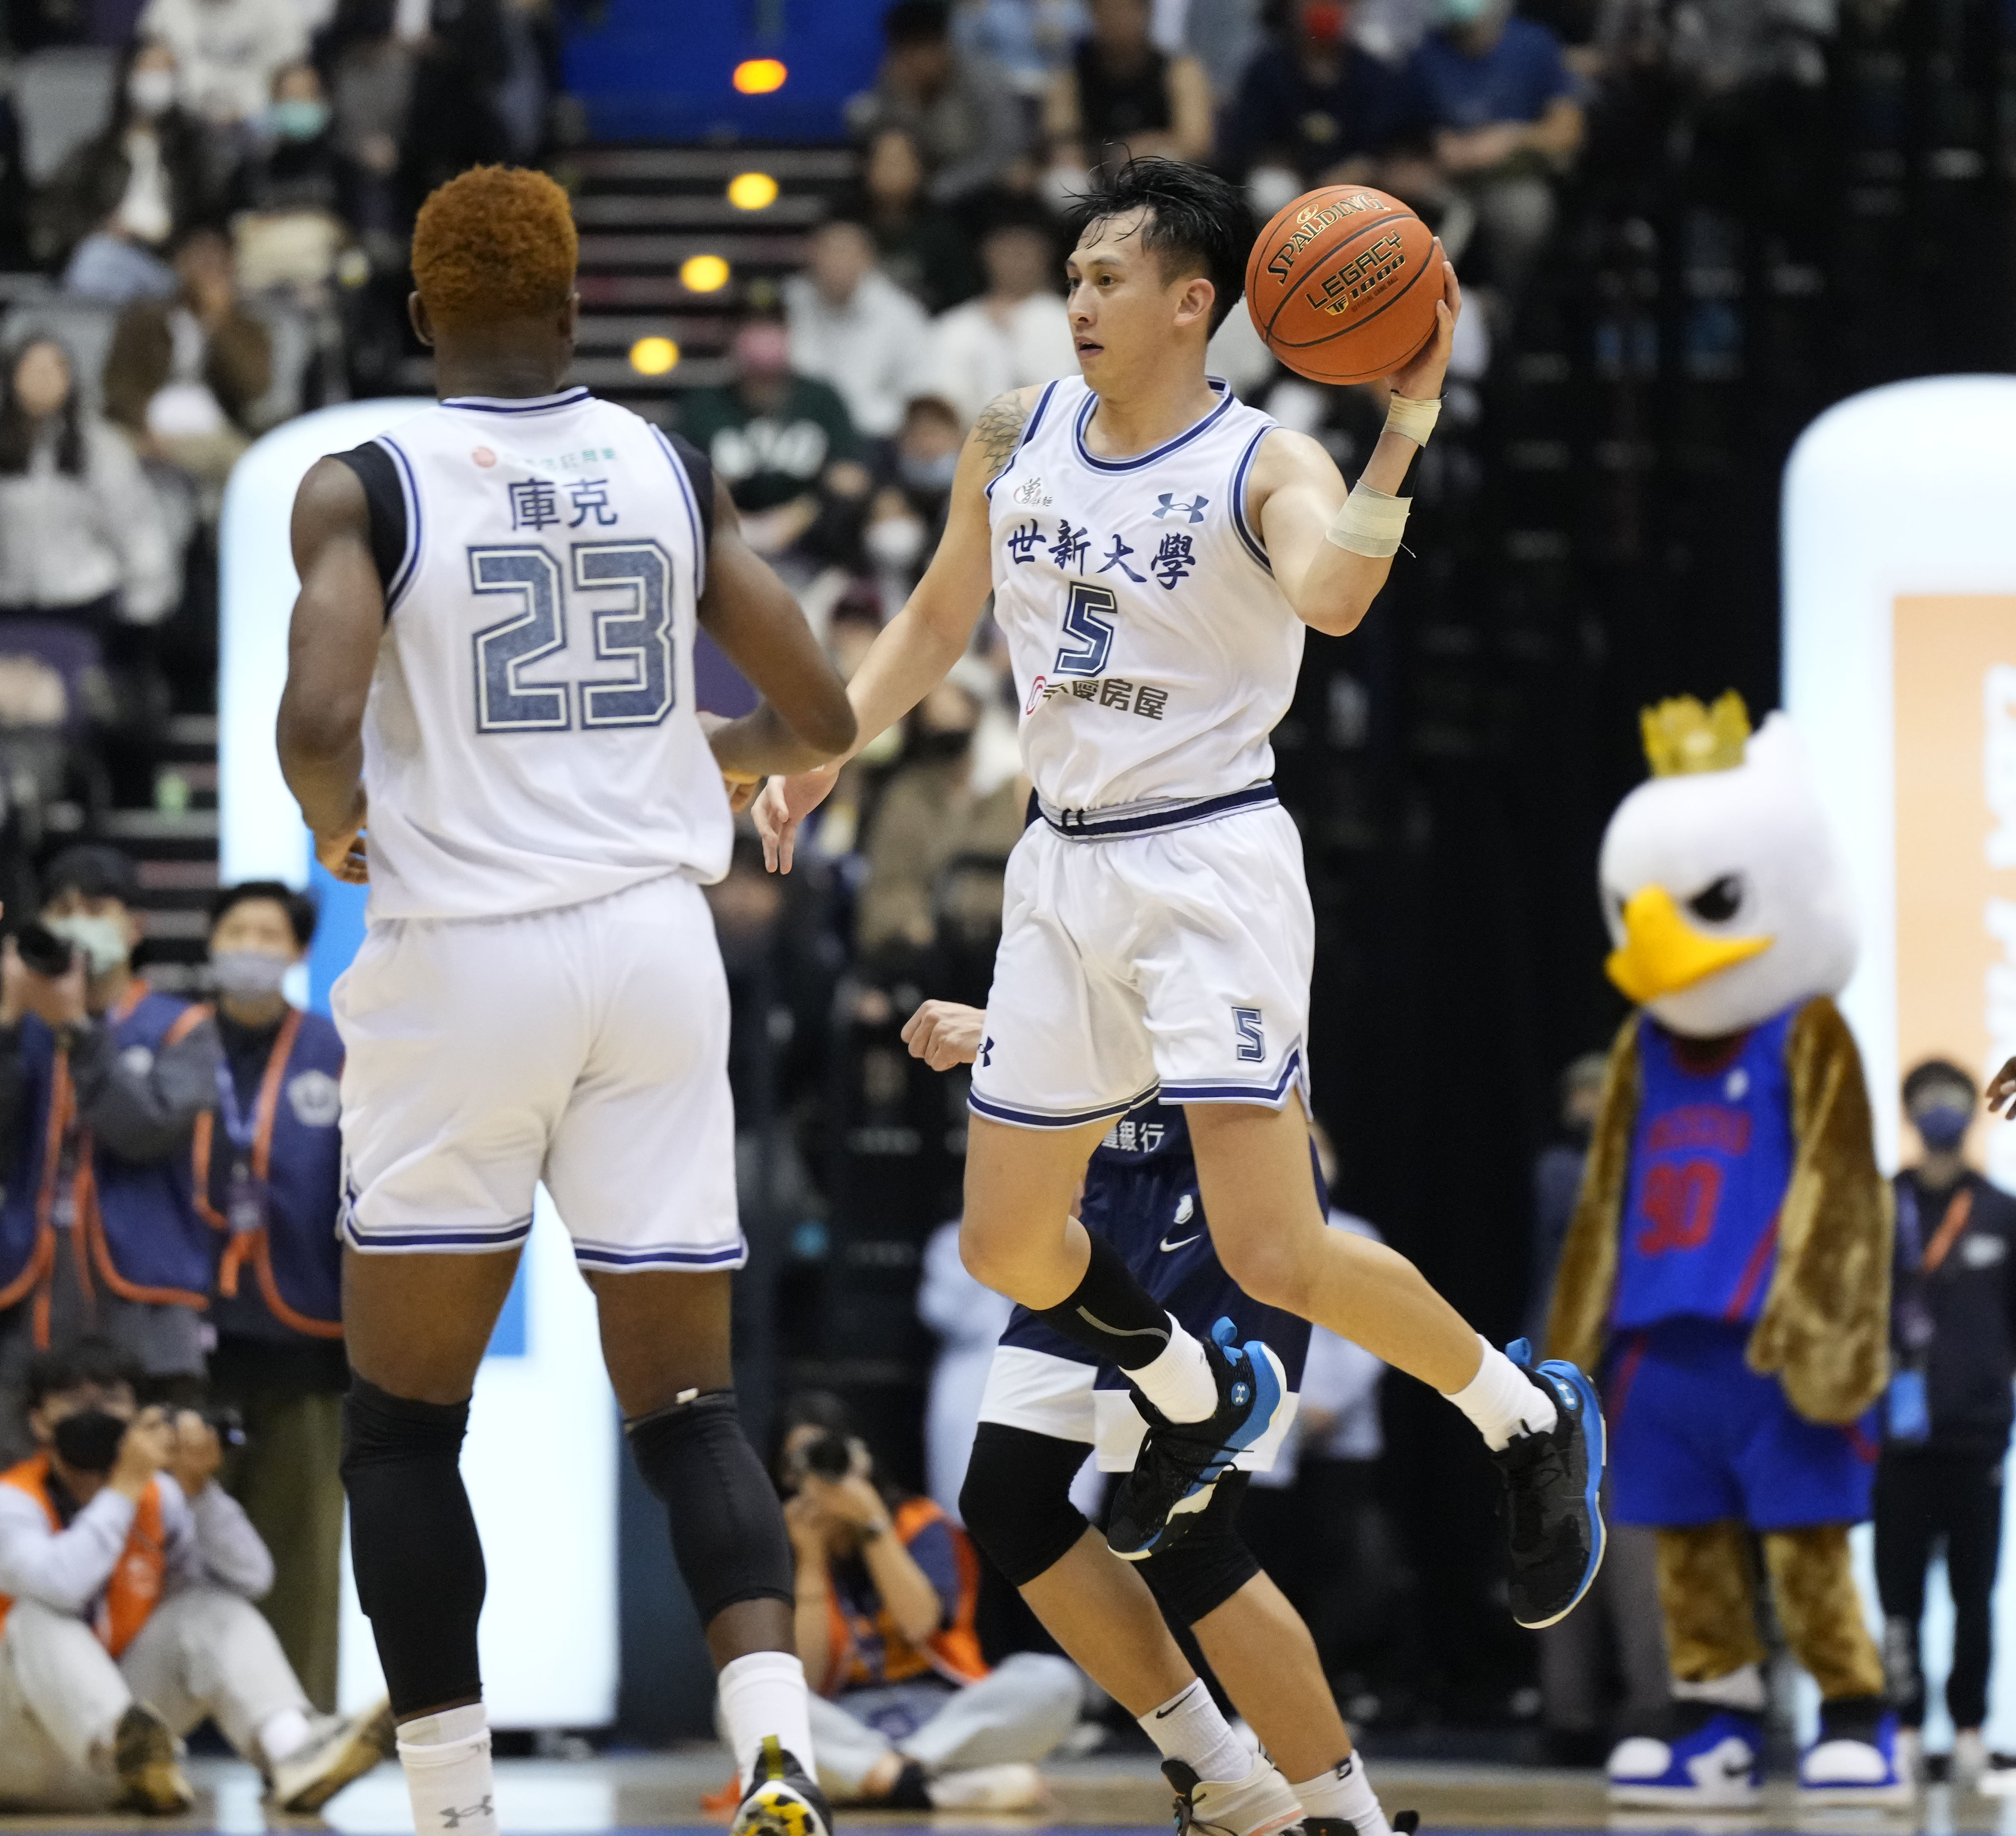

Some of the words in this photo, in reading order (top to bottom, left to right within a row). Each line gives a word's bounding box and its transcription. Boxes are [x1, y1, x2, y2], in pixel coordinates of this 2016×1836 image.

[1267, 192, 1386, 286] SPALDING
[1306, 230, 1402, 311] LEGACY
[1325, 296, 1349, 315] TF
[1349, 253, 1406, 301] 1000
[508, 478, 619, 532] 庫克
[1008, 518, 1196, 590] 世新大學
[466, 539, 676, 734] 23
[1053, 580, 1118, 678] 5
[1231, 1006, 1265, 1063] 5
